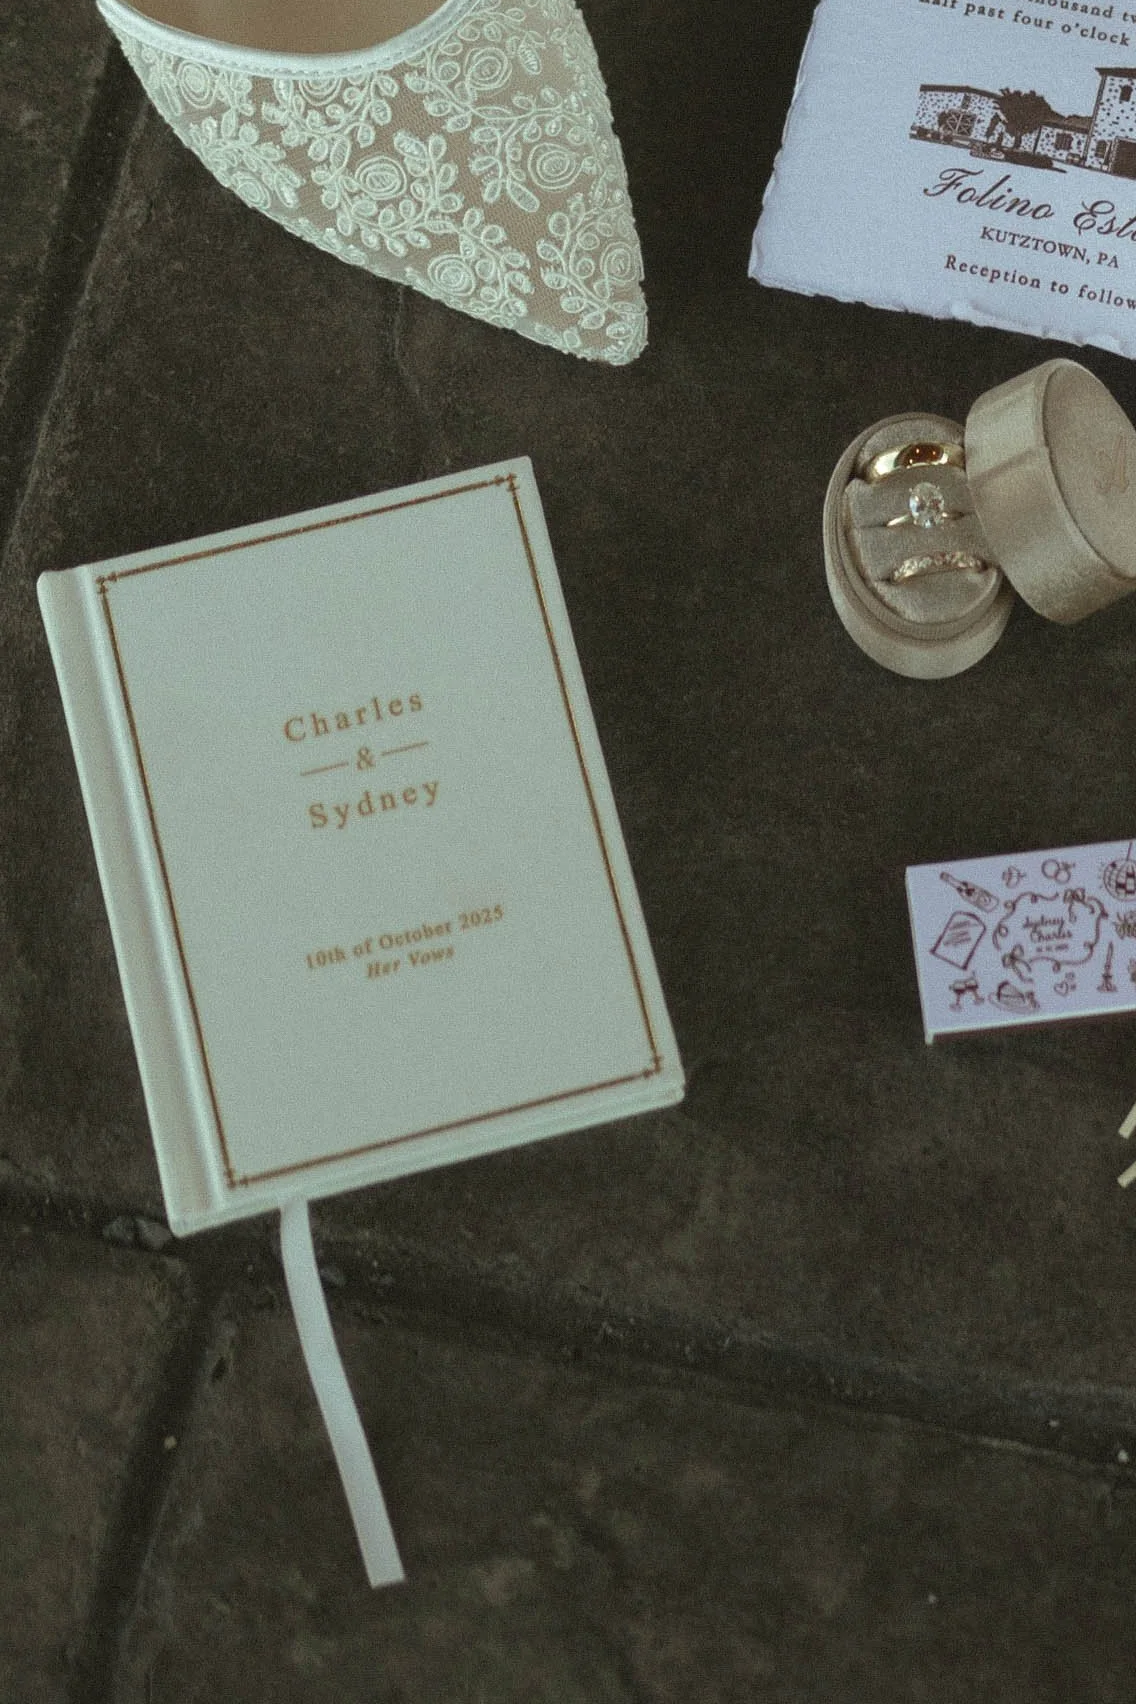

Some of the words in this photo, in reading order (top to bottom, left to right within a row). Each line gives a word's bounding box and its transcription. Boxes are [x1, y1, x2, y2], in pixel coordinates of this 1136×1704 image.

[963, 3, 1005, 19] past
[1012, 9, 1054, 30] four
[923, 168, 1055, 220] Folino
[980, 226, 1090, 265] KUTZTOWN,
[1096, 251, 1119, 269] PA
[944, 254, 1041, 289] Reception
[1050, 281, 1069, 295] to
[284, 693, 423, 742] Charles
[356, 746, 376, 771] &
[308, 780, 440, 830] Sydney
[306, 945, 347, 971] 10th
[352, 937, 375, 958] of
[378, 920, 453, 951] October
[458, 904, 505, 932] 2025
[367, 959, 401, 980] Her
[408, 946, 456, 968] Vows
